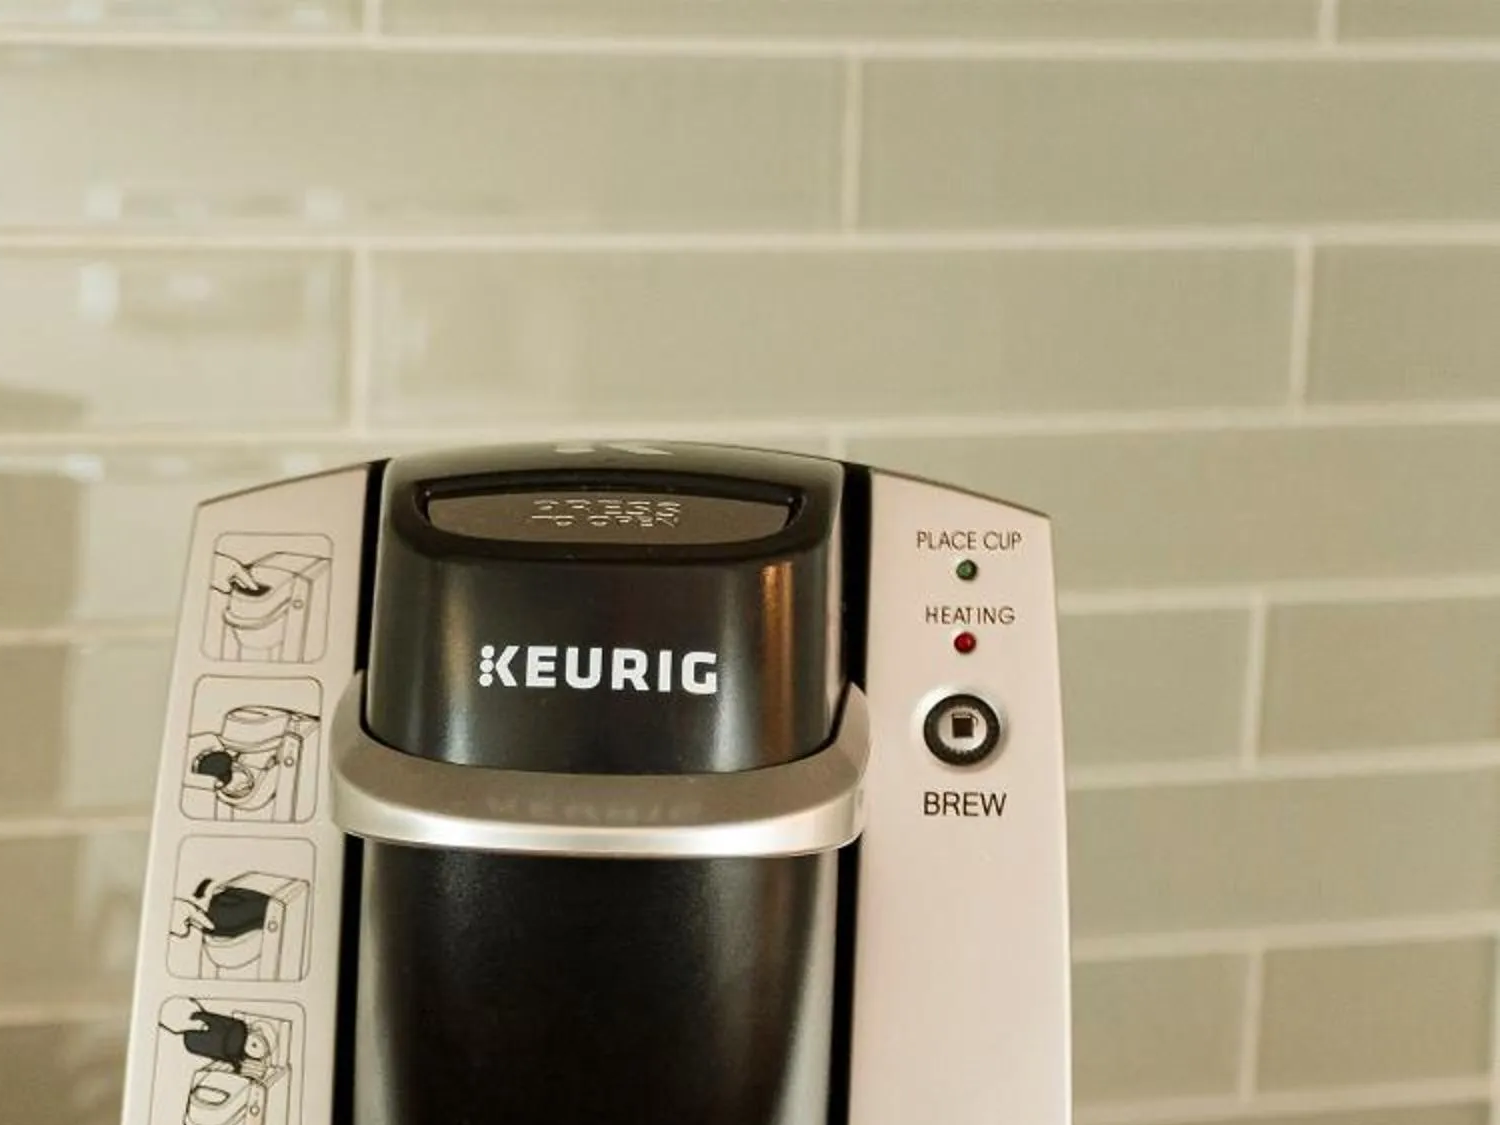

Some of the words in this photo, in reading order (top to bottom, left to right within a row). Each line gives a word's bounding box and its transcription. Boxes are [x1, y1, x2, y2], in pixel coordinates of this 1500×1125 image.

[916, 531, 977, 550] PLACE
[983, 531, 1023, 550] CUP
[925, 606, 1016, 625] HEATING
[479, 645, 718, 695] KEURIG
[924, 791, 1007, 817] BREW
